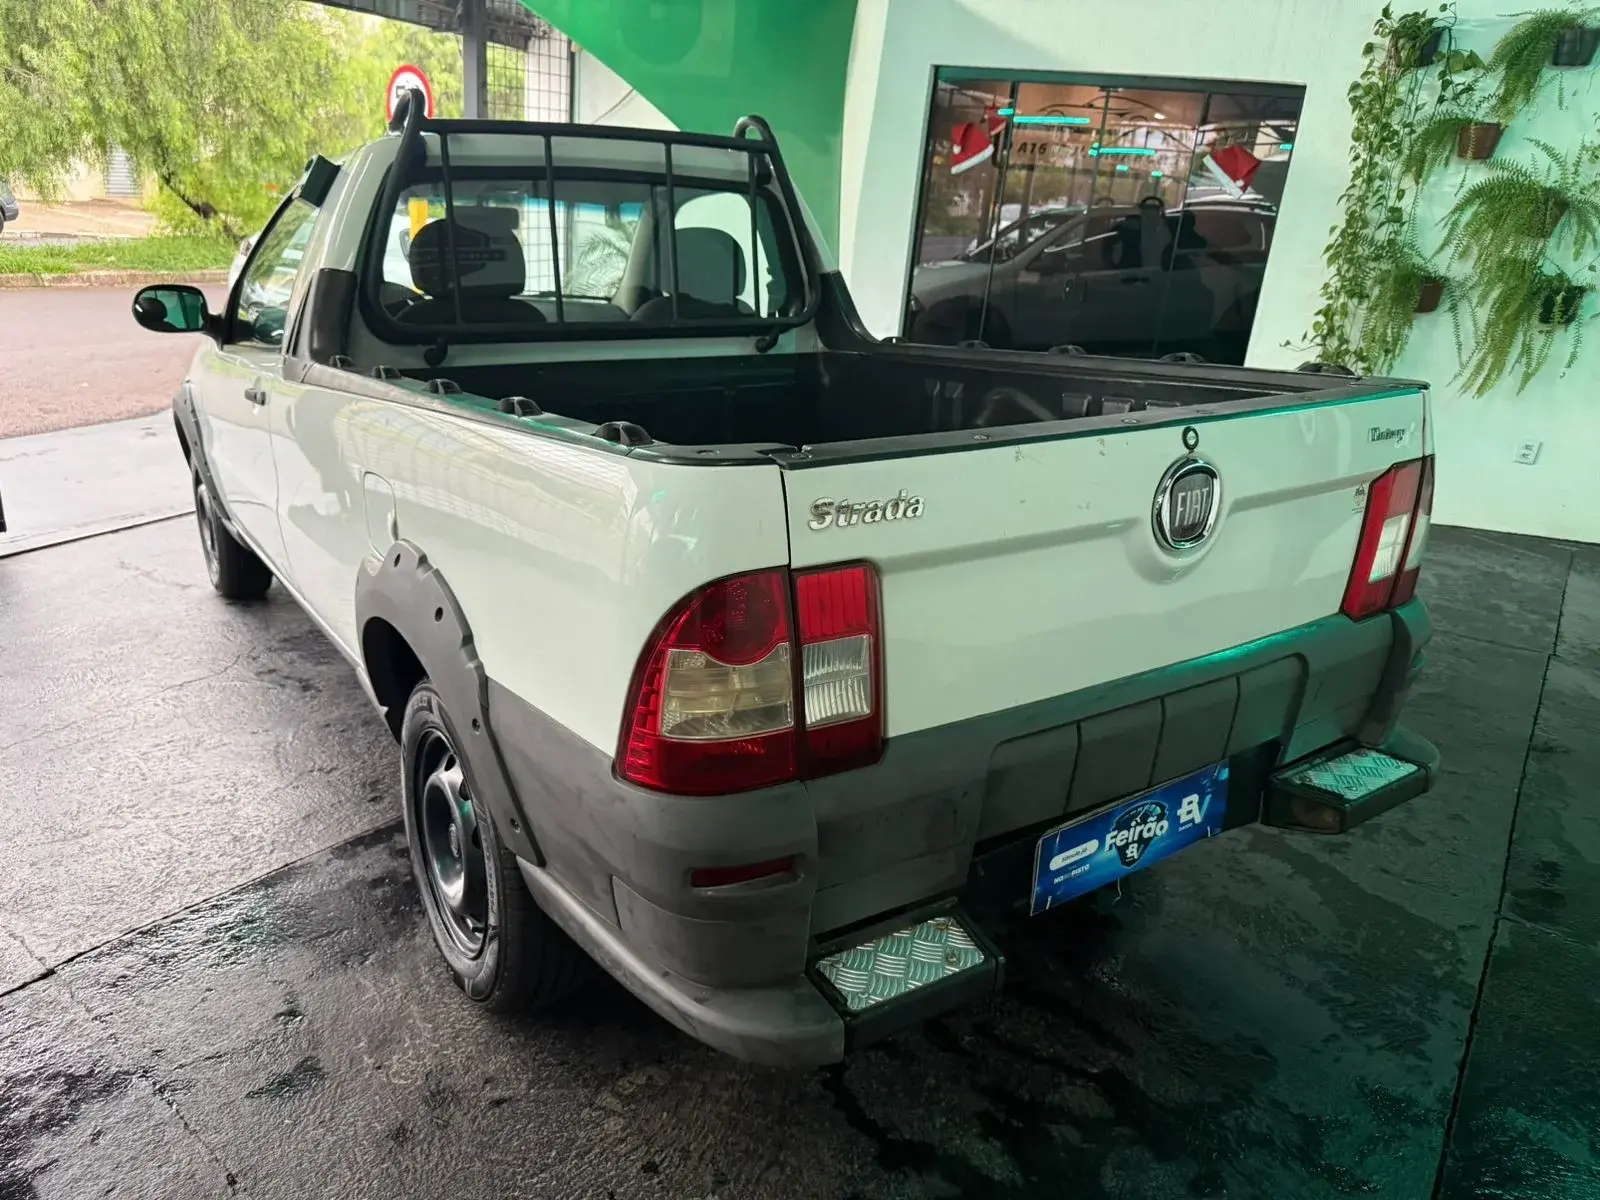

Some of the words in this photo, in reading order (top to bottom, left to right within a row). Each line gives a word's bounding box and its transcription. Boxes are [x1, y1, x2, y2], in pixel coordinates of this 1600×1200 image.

[808, 488, 925, 531] Strada
[1174, 487, 1209, 527] FIAT
[1104, 816, 1169, 852] Feirão
